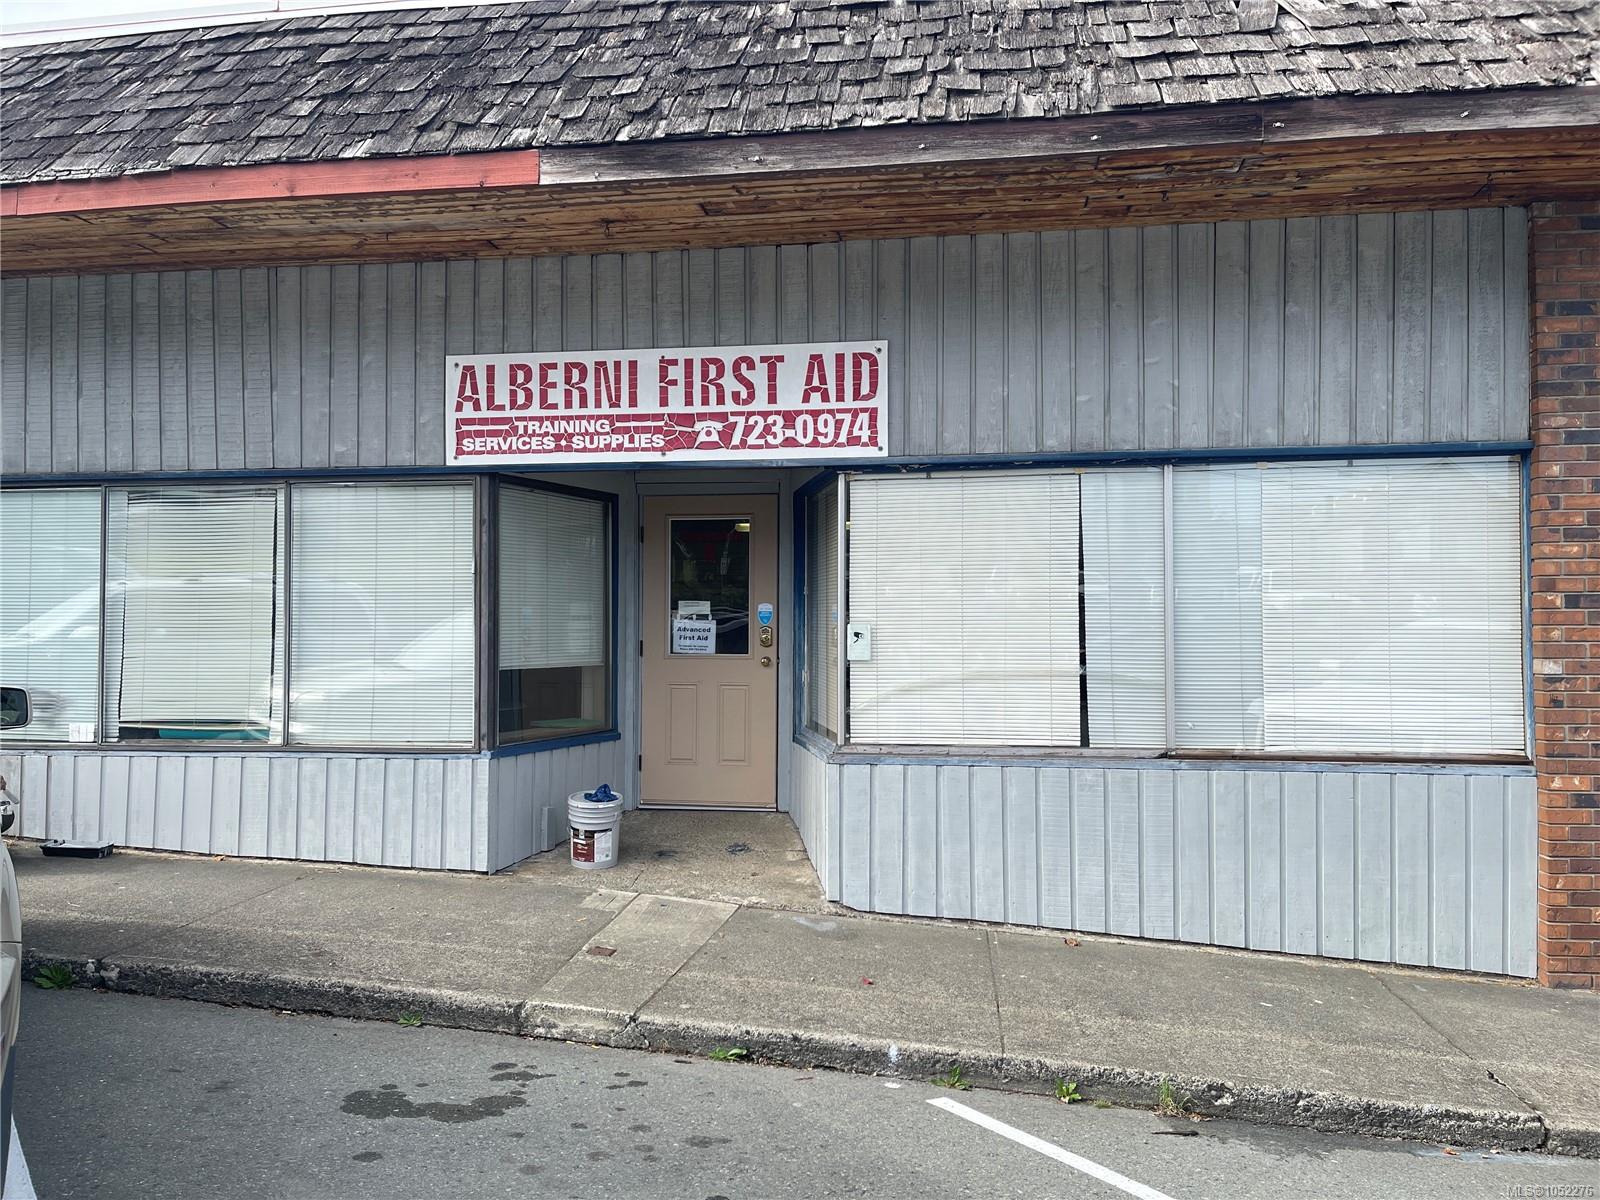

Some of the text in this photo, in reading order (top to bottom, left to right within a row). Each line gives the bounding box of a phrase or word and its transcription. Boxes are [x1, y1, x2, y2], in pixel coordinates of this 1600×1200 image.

[454, 350, 879, 413] ALBERNI FIRST AID
[513, 418, 611, 435] TRAINING
[729, 412, 871, 446] 723-0974
[462, 433, 666, 452] SERVICES SUPPLIES
